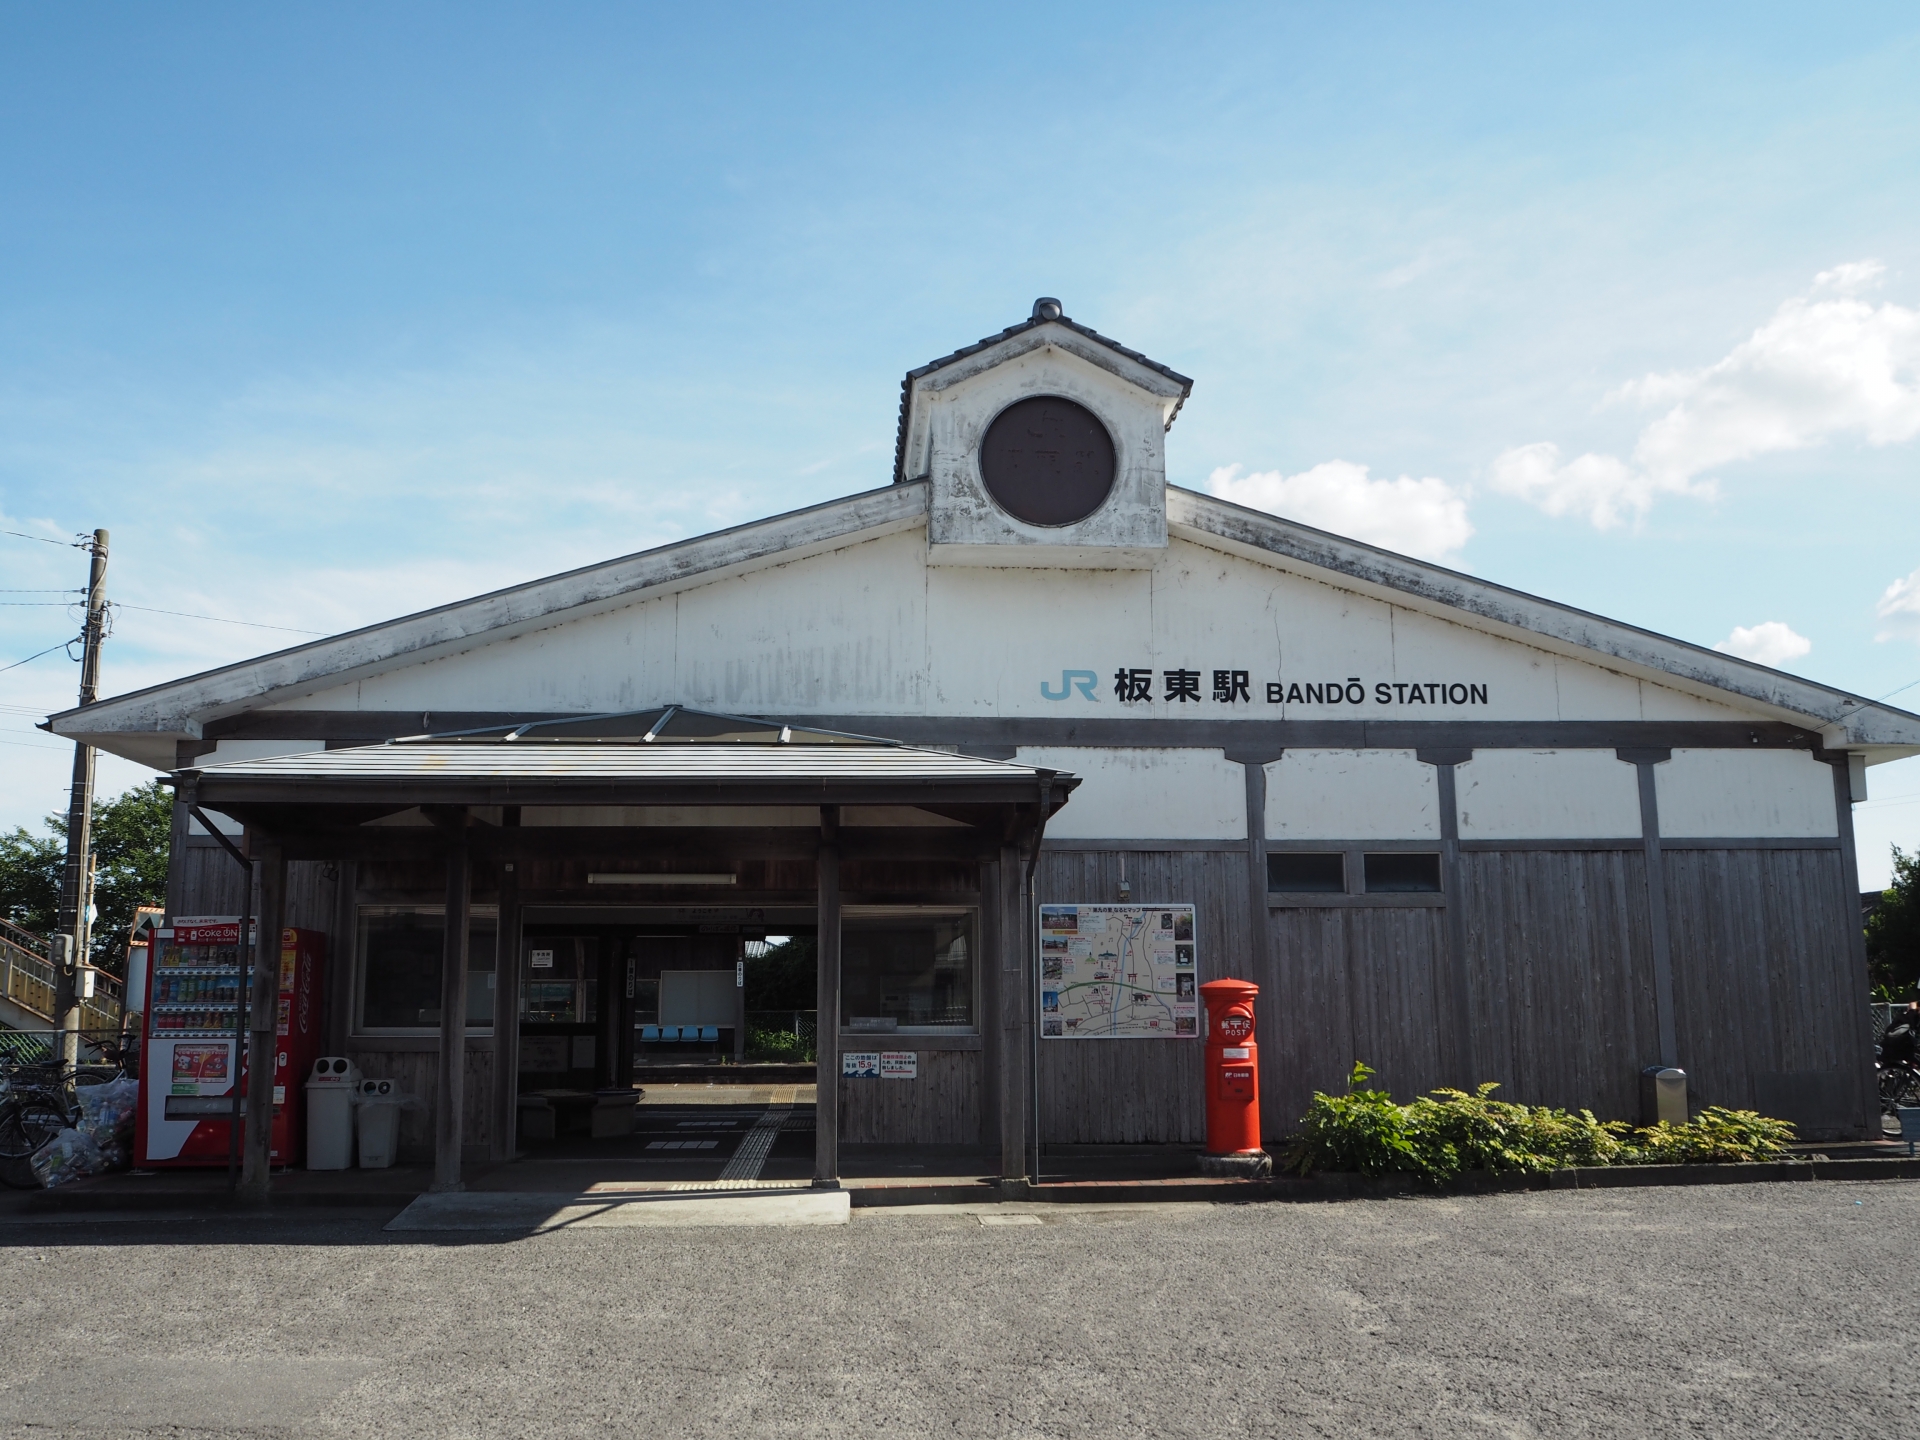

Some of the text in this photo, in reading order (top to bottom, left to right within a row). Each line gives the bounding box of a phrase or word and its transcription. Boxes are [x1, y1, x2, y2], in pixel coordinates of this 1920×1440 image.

[1040, 667, 1489, 705] JR 板東駅 BANDŌ STATION
[198, 927, 238, 937] Coke ON
